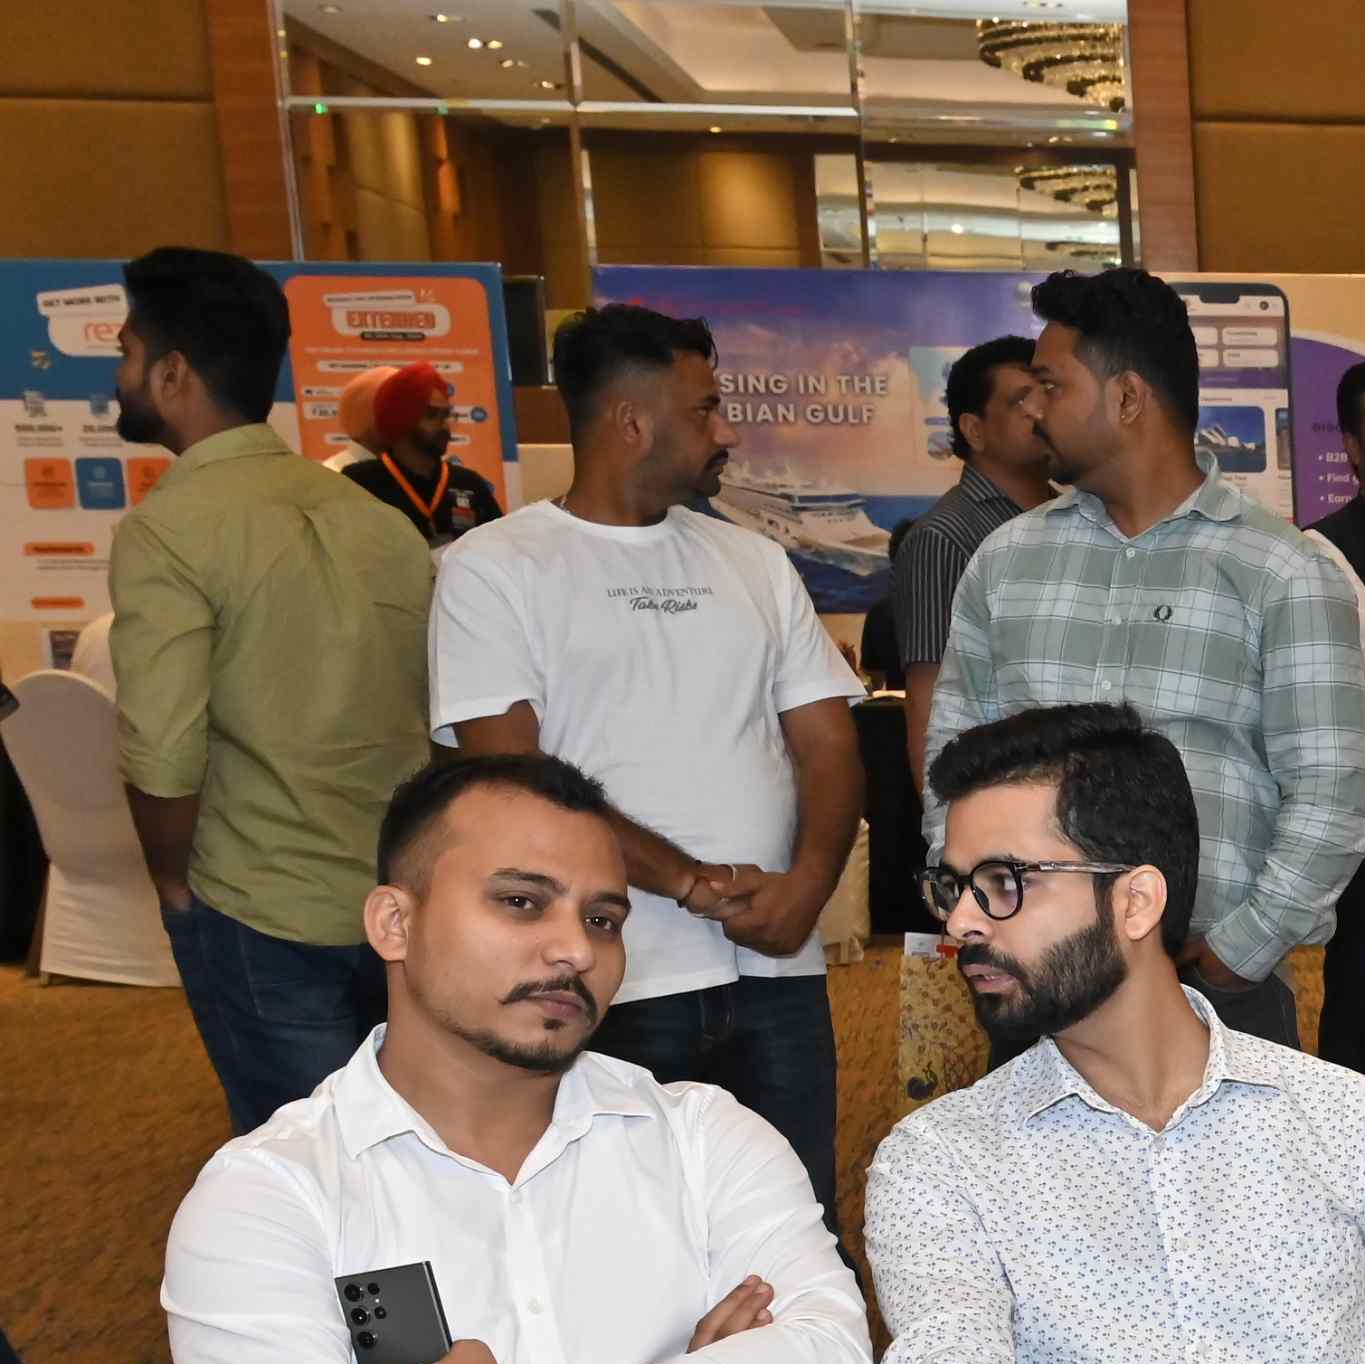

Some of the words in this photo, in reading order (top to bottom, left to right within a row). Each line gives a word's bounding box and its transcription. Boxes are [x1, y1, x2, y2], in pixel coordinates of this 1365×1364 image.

[716, 373, 788, 394] SING
[799, 374, 826, 395] IN
[836, 375, 888, 395] THE
[727, 403, 796, 424] BIAN
[806, 403, 874, 424] GULF
